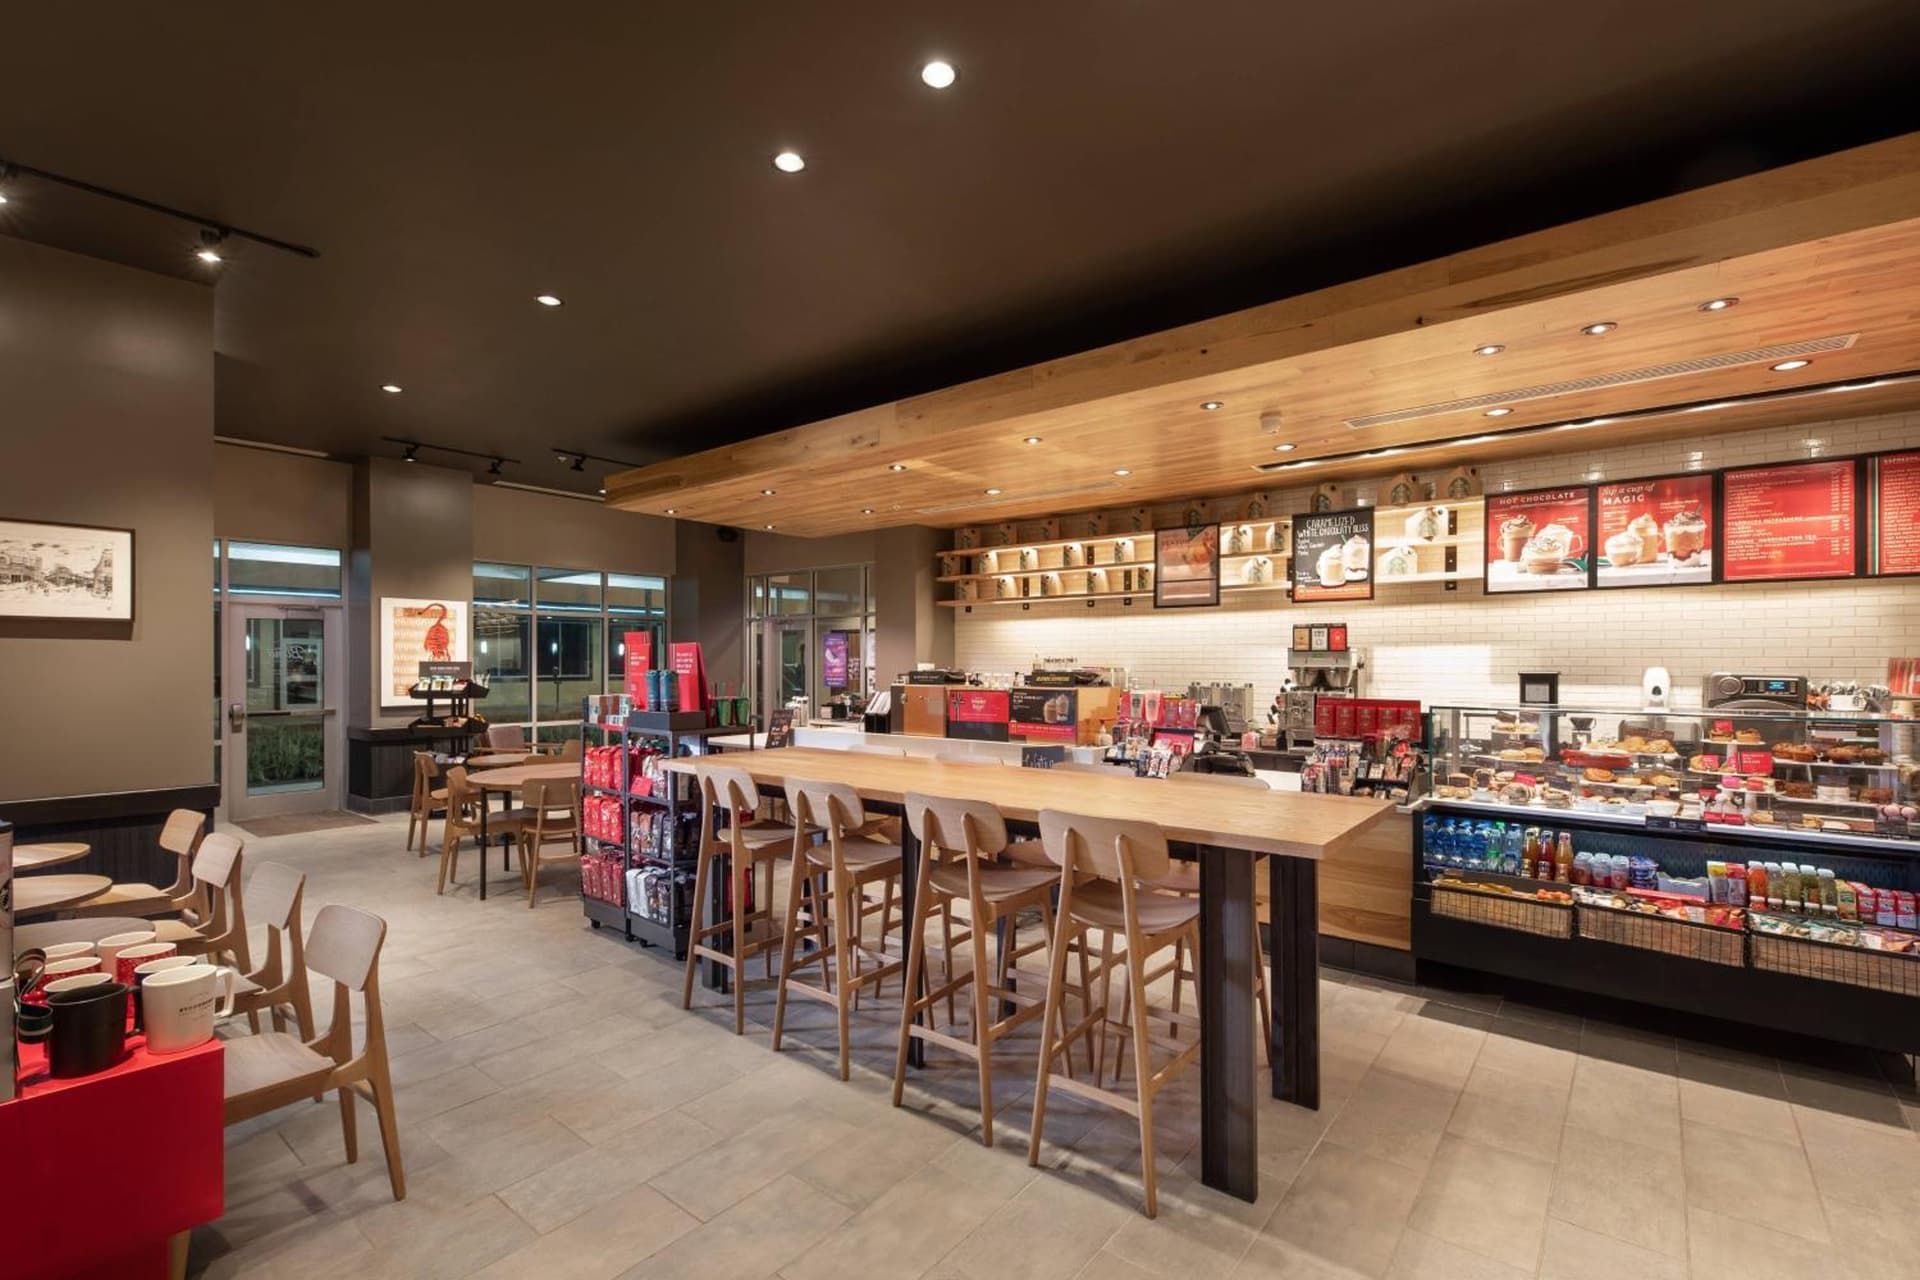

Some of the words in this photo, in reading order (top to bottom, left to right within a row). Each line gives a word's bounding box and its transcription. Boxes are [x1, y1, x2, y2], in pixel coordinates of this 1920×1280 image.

[1499, 496, 1519, 505] HOT
[1520, 491, 1575, 503] CHOCOLATE
[1602, 494, 1645, 506] MAGIC
